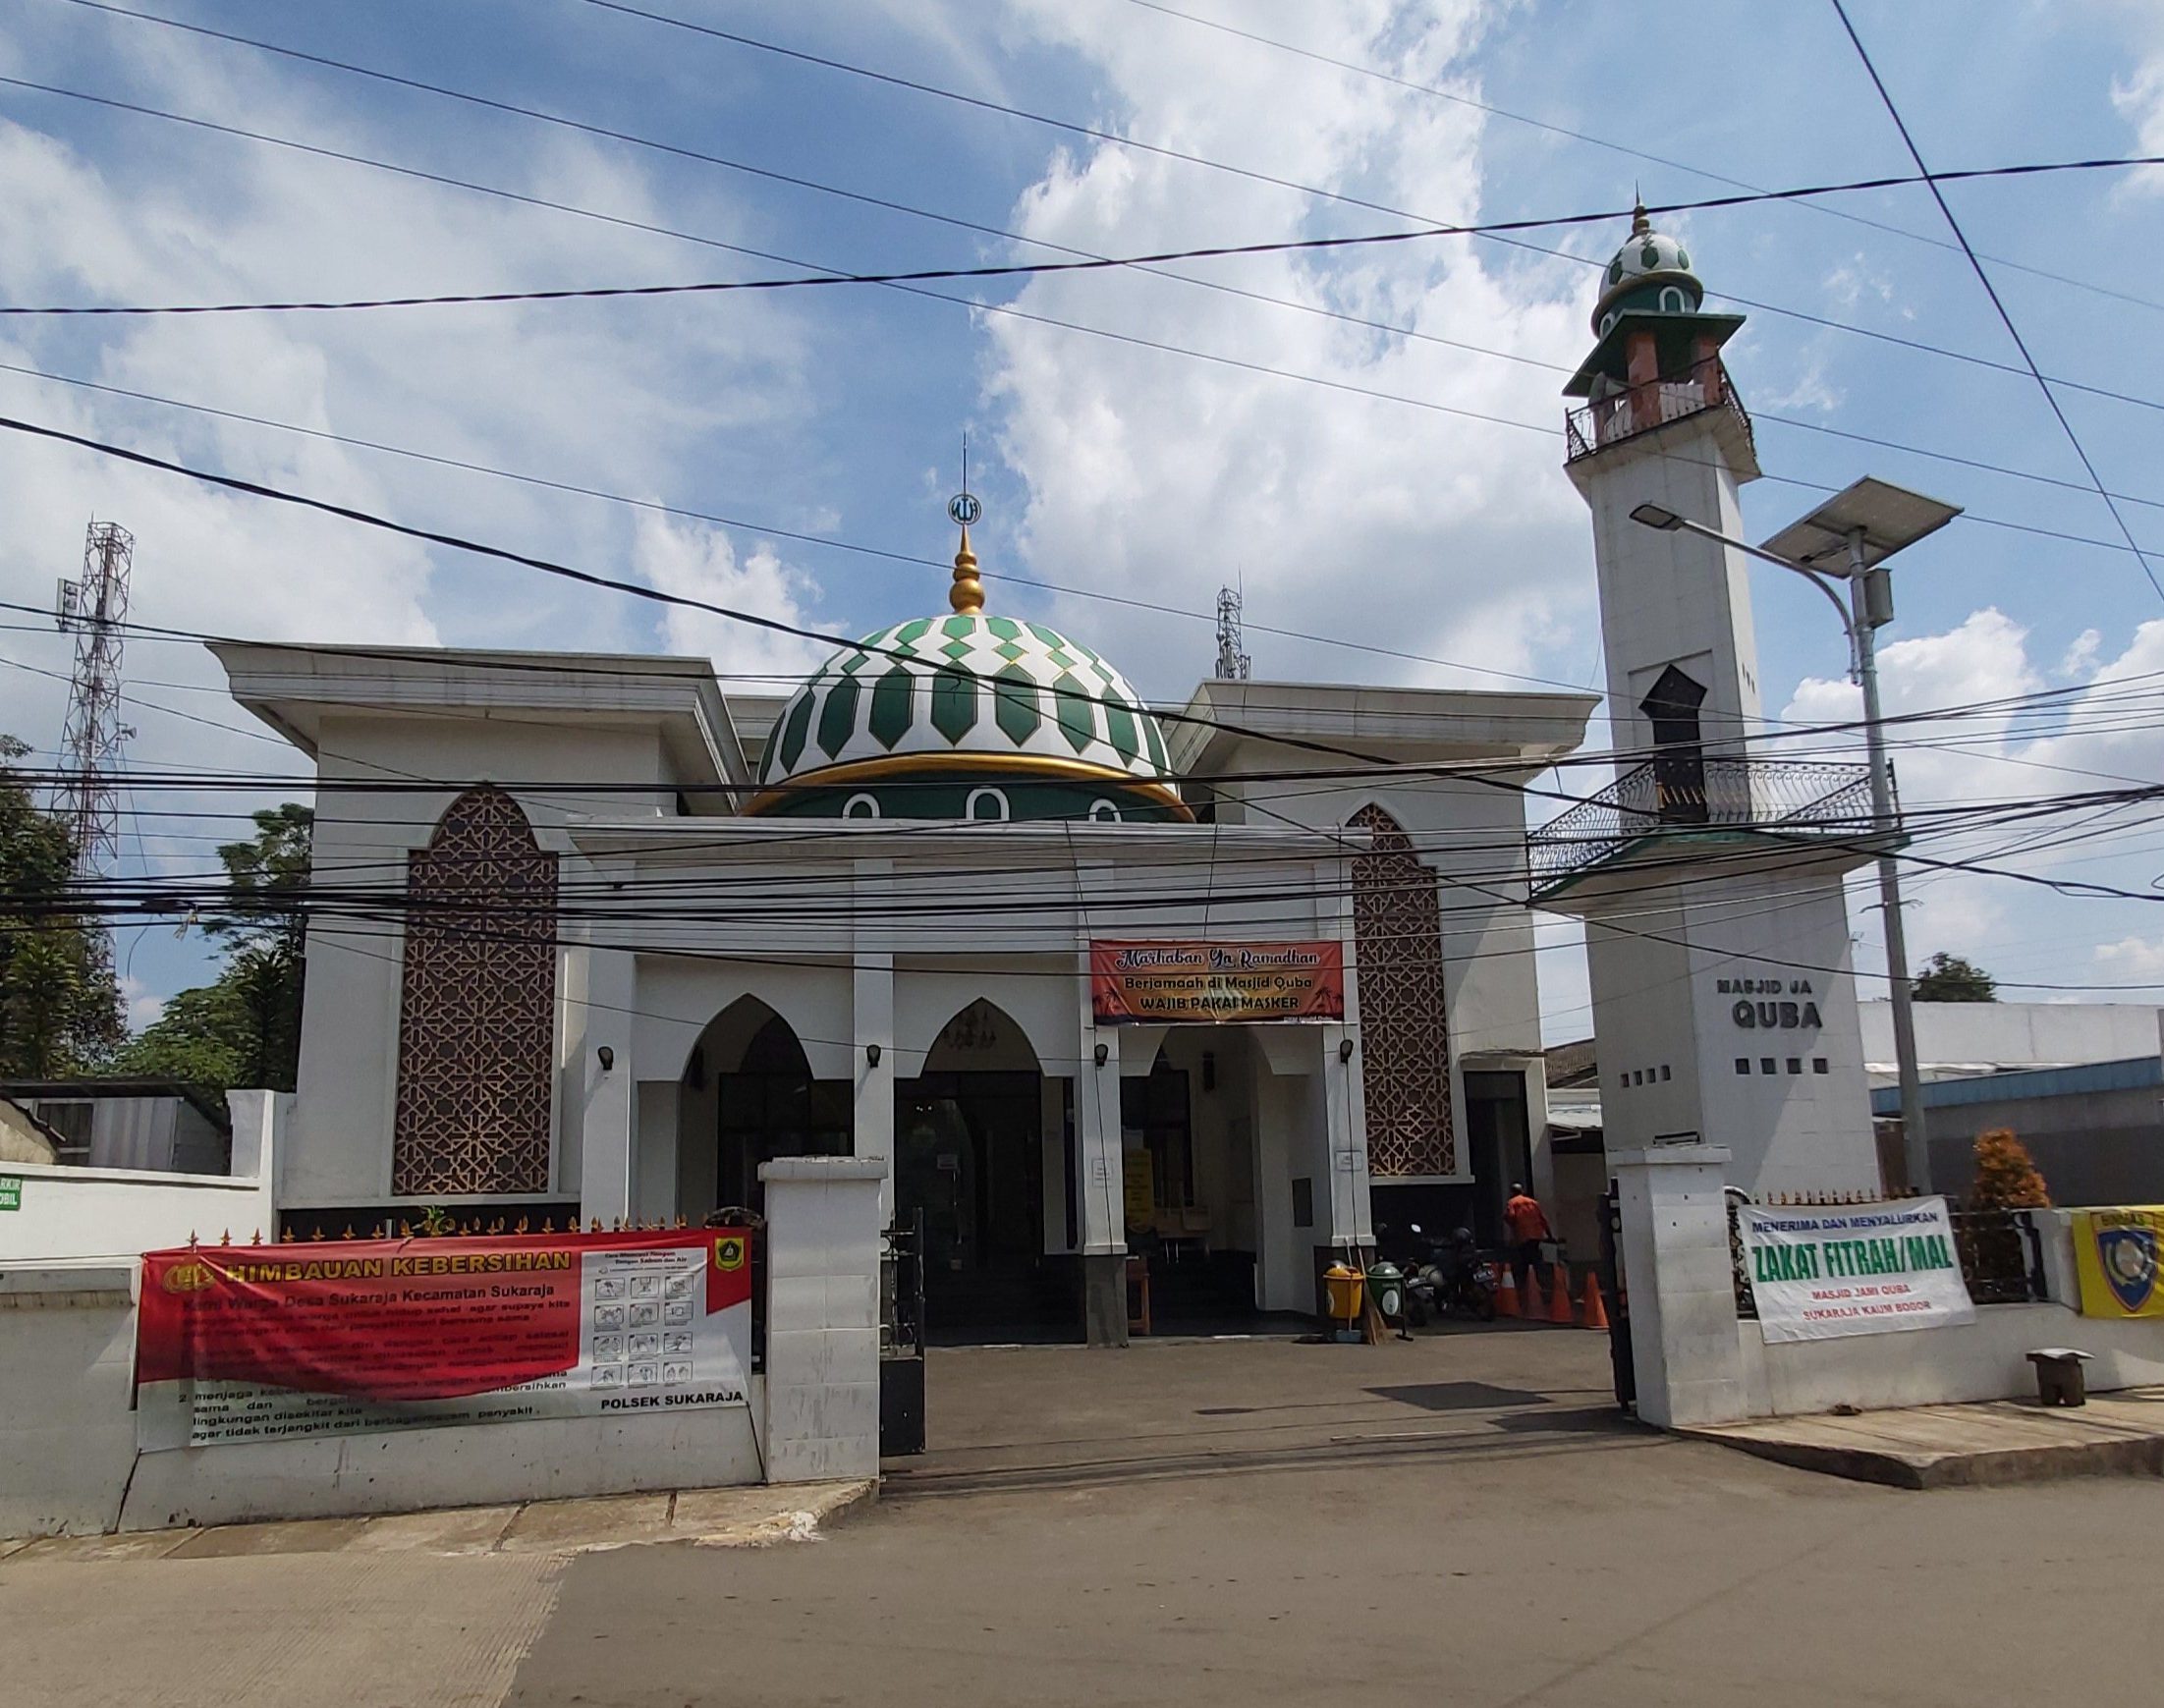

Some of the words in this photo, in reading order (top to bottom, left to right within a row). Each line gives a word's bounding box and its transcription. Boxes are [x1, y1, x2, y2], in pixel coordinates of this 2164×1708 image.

[1116, 949, 1204, 969] Marhaban
[1209, 949, 1235, 968] Ya
[1241, 949, 1319, 968] Ramadhan
[1125, 976, 1203, 990] Berjamaah
[1207, 976, 1220, 989] di
[1225, 976, 1270, 991] Masjid
[1274, 976, 1312, 991] Quba
[1716, 979, 1782, 994] MASJID
[1789, 979, 1812, 994] JA
[1140, 997, 1187, 1010] WAJIB
[1191, 997, 1236, 1010] PAKAI
[1241, 996, 1299, 1010] MASKER
[1732, 1000, 1822, 1028] QUBA
[1752, 1218, 1818, 1233] MENERIMA
[1823, 1217, 1847, 1229] DAN
[1850, 1212, 1937, 1229] MENYALURKAN
[226, 1257, 382, 1284] HIMBAUAN
[392, 1250, 571, 1277] KEBERSIHAN
[1751, 1243, 1819, 1283] ZAKAT
[1822, 1235, 1954, 1277] FITRAH/MAL
[285, 1295, 324, 1307] Desa
[329, 1290, 397, 1305] Sukaraja
[403, 1287, 486, 1302] Kecamatan
[491, 1284, 554, 1298] Sukaraja
[1812, 1288, 1851, 1300] MASJID
[1855, 1286, 1879, 1298] JAMI
[1881, 1284, 1912, 1295] QUBA
[1803, 1307, 1860, 1321] SUKARAJA
[1862, 1304, 1894, 1317] KAUM
[1895, 1300, 1932, 1314] BOGOR
[247, 1401, 272, 1410] dan
[601, 1396, 660, 1409] POLSEK
[665, 1391, 743, 1405] SUKARAJA
[193, 1412, 270, 1427] lingkungan
[274, 1409, 333, 1421] disekitar
[192, 1430, 223, 1441] agar
[225, 1426, 259, 1437] tidak
[264, 1420, 330, 1436] terjangkit
[334, 1419, 361, 1429] dari
